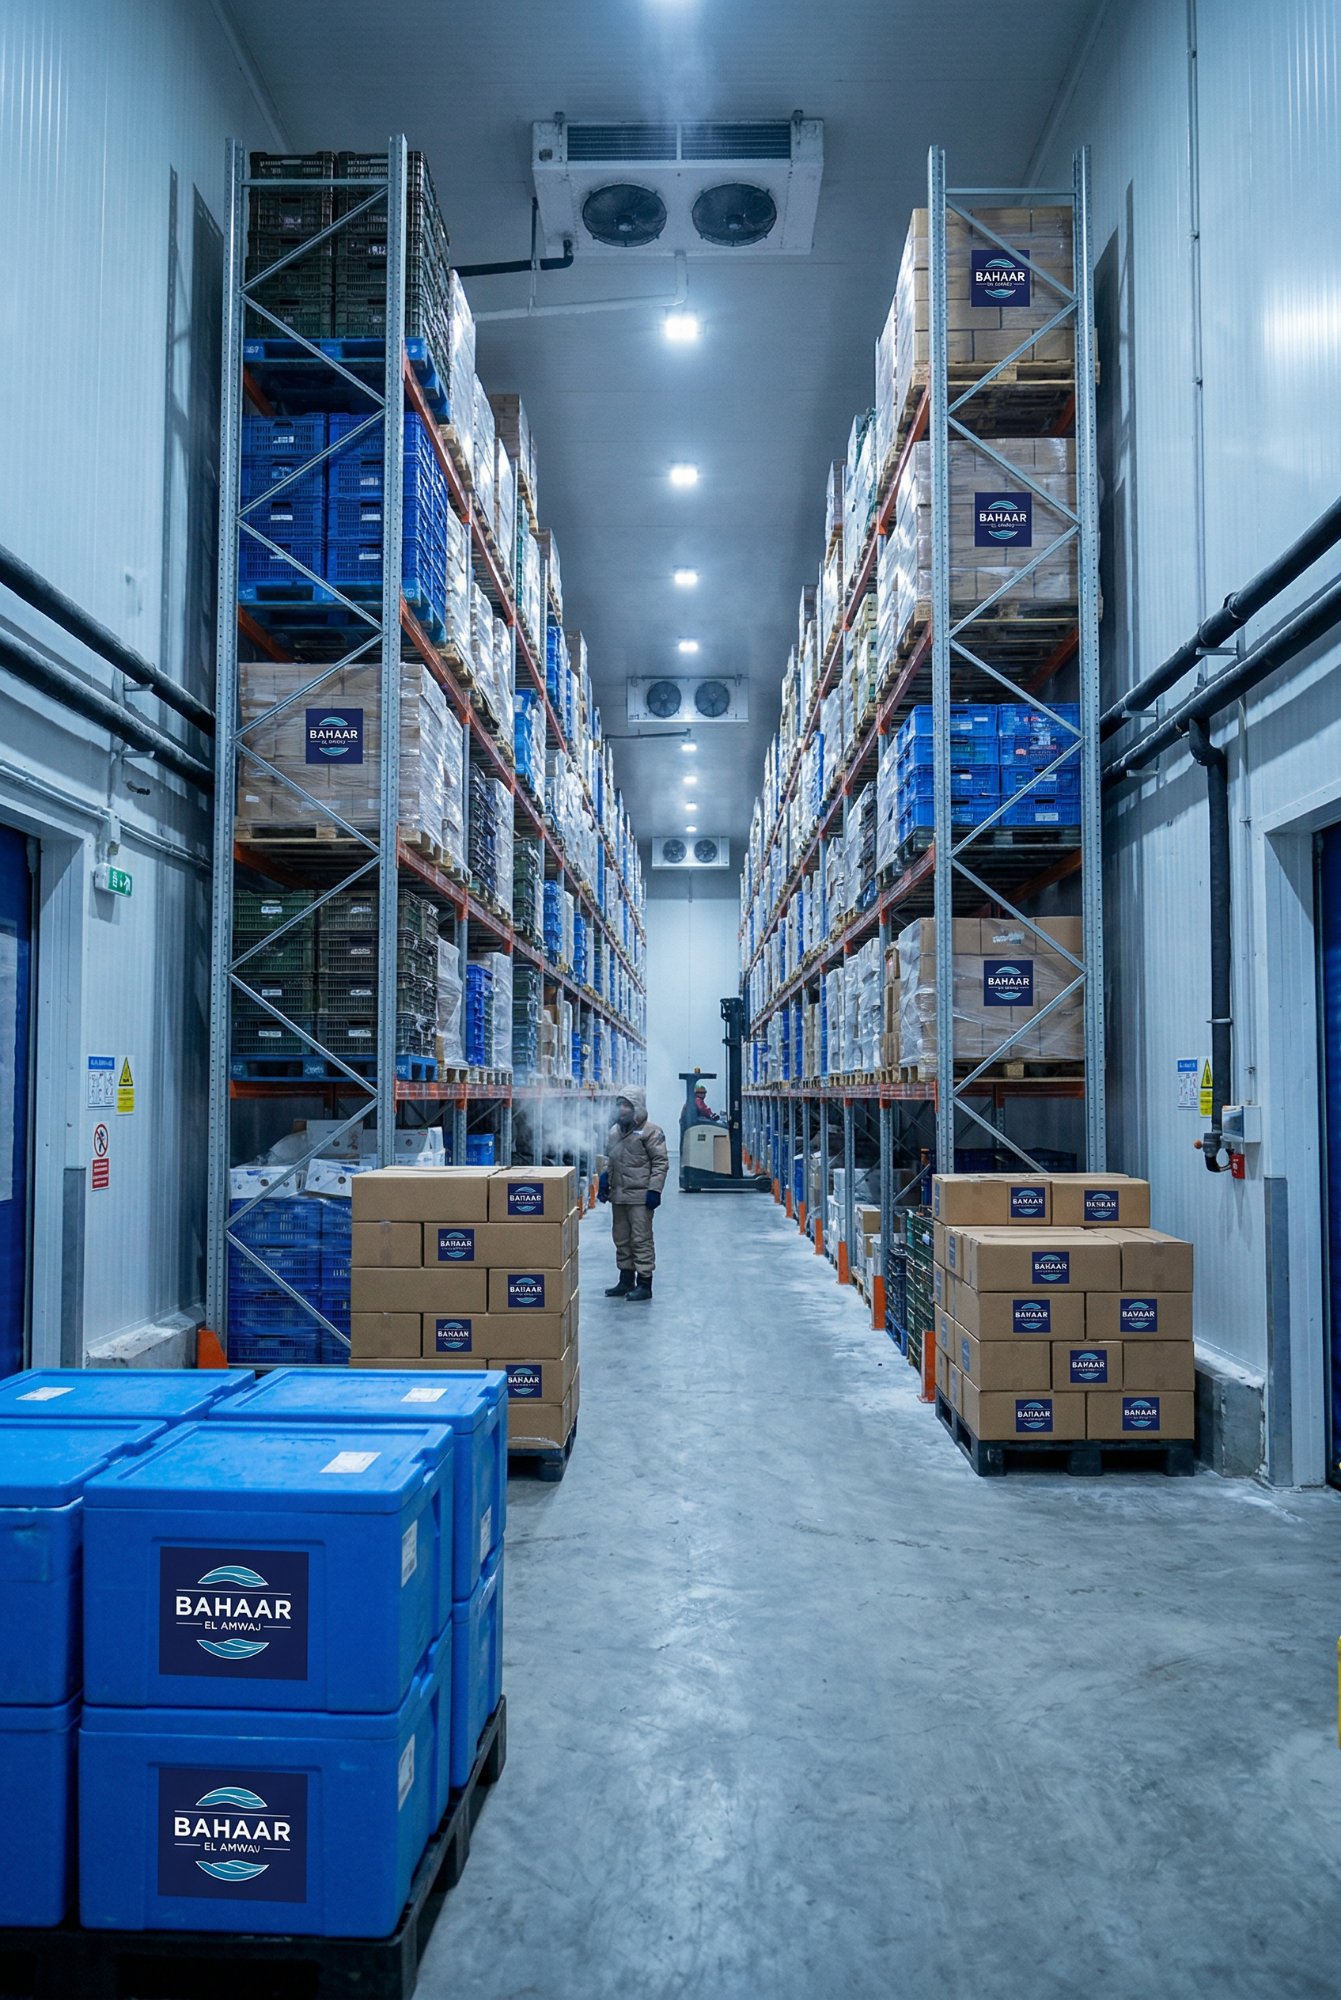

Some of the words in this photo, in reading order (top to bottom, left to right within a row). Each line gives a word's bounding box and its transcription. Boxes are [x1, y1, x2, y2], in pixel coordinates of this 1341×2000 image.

[975, 272, 1025, 282] BAHAAR
[979, 514, 1026, 523] BAHAAR
[309, 730, 358, 739] BAHAAR
[988, 978, 1030, 986] BAHAAR
[175, 1596, 292, 1619] BAHAAR
[204, 1620, 218, 1630] EL
[220, 1621, 261, 1632] AMWAJ
[174, 1816, 291, 1841] BAHAAR
[204, 1841, 217, 1851] EL
